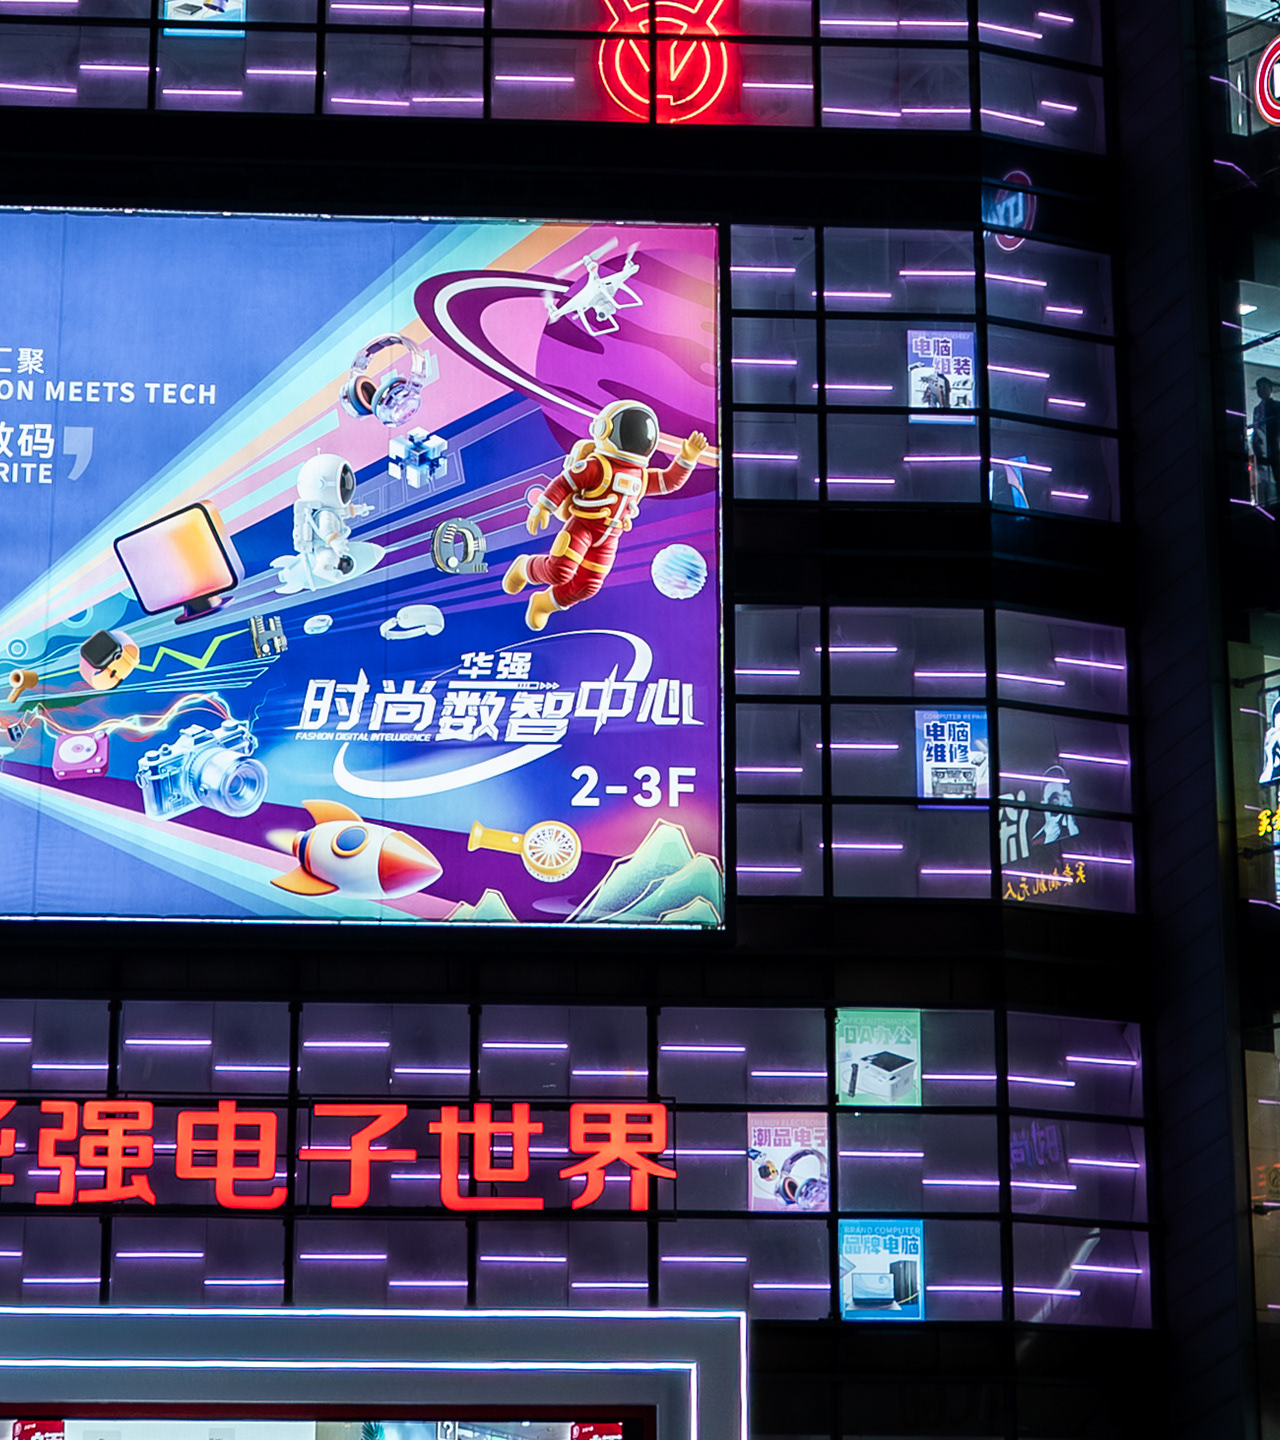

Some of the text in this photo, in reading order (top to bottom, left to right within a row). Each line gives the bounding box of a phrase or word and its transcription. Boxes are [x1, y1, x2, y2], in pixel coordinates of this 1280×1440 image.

[913, 337, 953, 357] 电脑
[933, 357, 972, 376] 组装
[45, 381, 135, 404] MEETS
[144, 383, 218, 406] TECH
[457, 651, 533, 680] 华强
[284, 664, 705, 743] 时尚数智中心
[295, 731, 431, 742] FASHION DIGITAL INTELLIGENCE
[925, 722, 969, 743] 电脑
[925, 743, 969, 764] 维修
[570, 765, 697, 808] 2-3F
[844, 1025, 913, 1045] OA办公
[844, 1226, 921, 1234] BRAND COMPUTER
[844, 1234, 920, 1255] 品牌电脑
